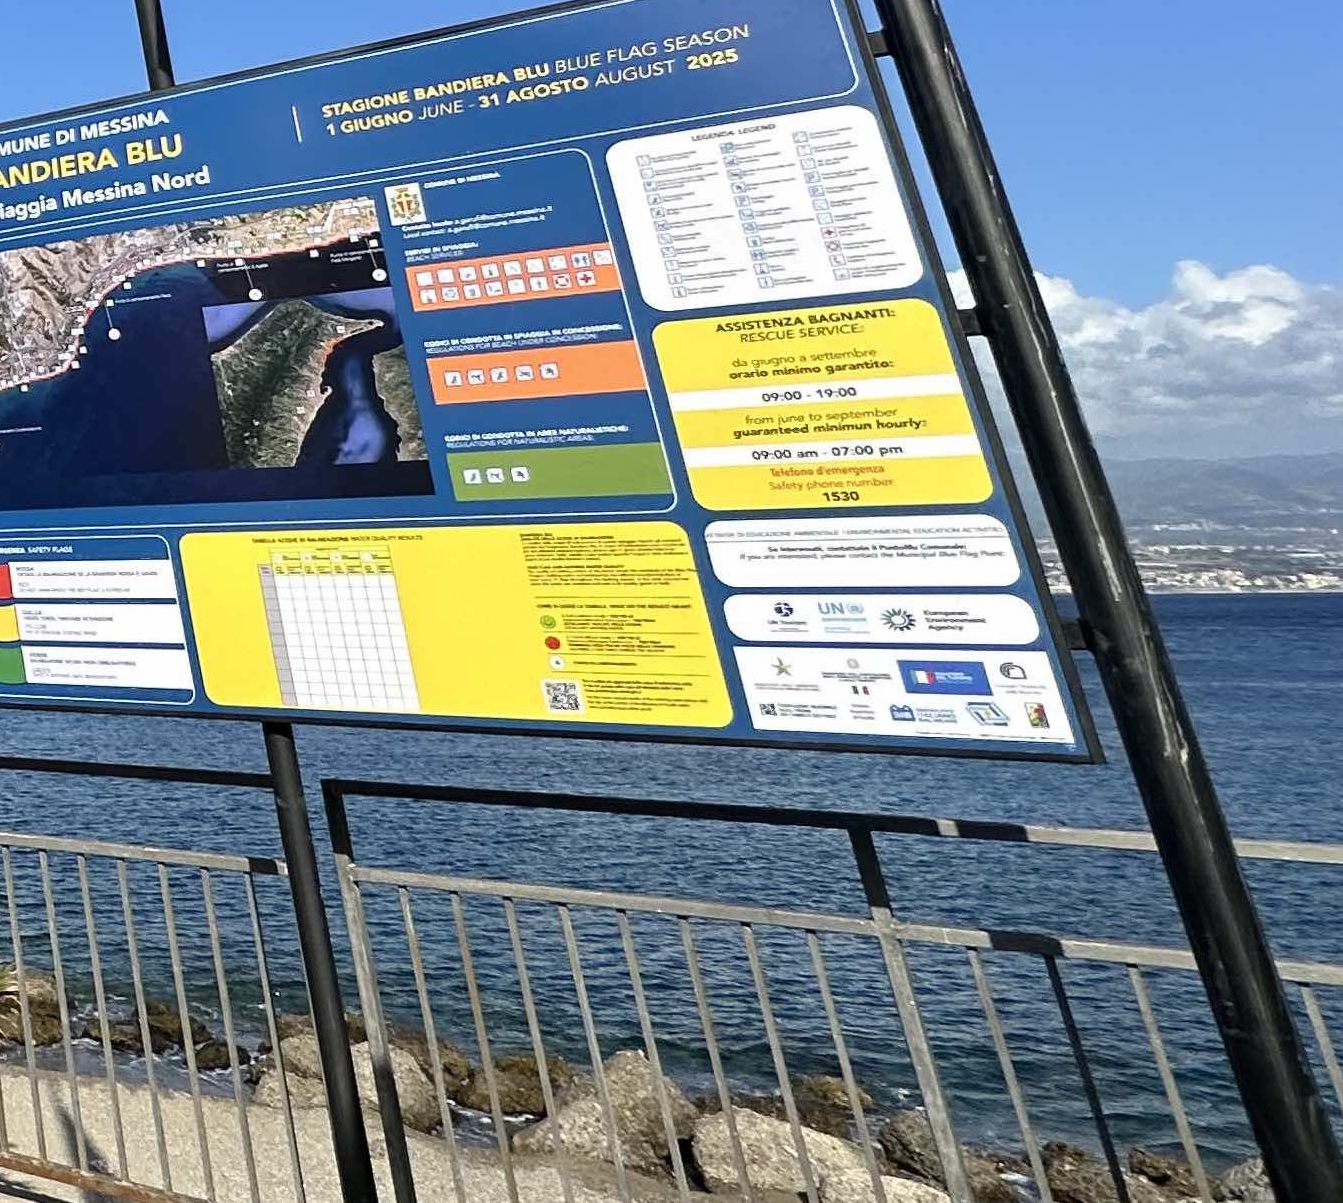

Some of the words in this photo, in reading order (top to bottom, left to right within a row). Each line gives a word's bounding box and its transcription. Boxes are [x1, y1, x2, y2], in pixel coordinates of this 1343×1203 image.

[322, 91, 410, 118] STAGIONE
[414, 72, 510, 101] BANDIERA
[513, 63, 550, 82] BLU
[555, 52, 601, 74] BLUE
[607, 42, 657, 63] FLAG
[664, 24, 749, 53] SEASON
[326, 123, 335, 136] 1
[340, 110, 413, 134] GIUGNO
[419, 100, 465, 120] JUNE
[479, 93, 500, 109] 31
[506, 76, 589, 104] AGOSTO
[595, 60, 675, 87] AUGUST
[686, 48, 739, 70] 2025
[56, 129, 75, 146] DI
[81, 109, 170, 141] MESSINA
[125, 133, 183, 166] BLU
[62, 180, 147, 209] Messina
[151, 165, 211, 193] Nord
[716, 316, 804, 333] ASSISTENZA
[809, 308, 896, 324] BAGNANTI:
[740, 329, 795, 343] RESCUE
[799, 323, 864, 338] SERVICE:
[732, 358, 748, 368] da
[751, 355, 795, 368] giugno
[810, 348, 877, 362] settembre
[730, 369, 768, 379] orario
[772, 365, 821, 376] minimo
[825, 359, 894, 375] garantito:
[762, 390, 802, 402] 09:00
[816, 387, 857, 398] 19:00
[745, 414, 774, 425] from
[778, 414, 805, 426] june
[808, 411, 823, 421] to
[825, 408, 898, 422] september
[733, 424, 809, 439] guaranteed
[752, 449, 792, 461] 09:00
[797, 450, 819, 458] am
[831, 445, 874, 456] 07:00
[879, 445, 904, 457] pm
[768, 480, 804, 491] Safety
[807, 478, 844, 490] phone
[846, 477, 893, 487] number
[822, 491, 860, 502] 1530
[818, 602, 845, 615] UN
